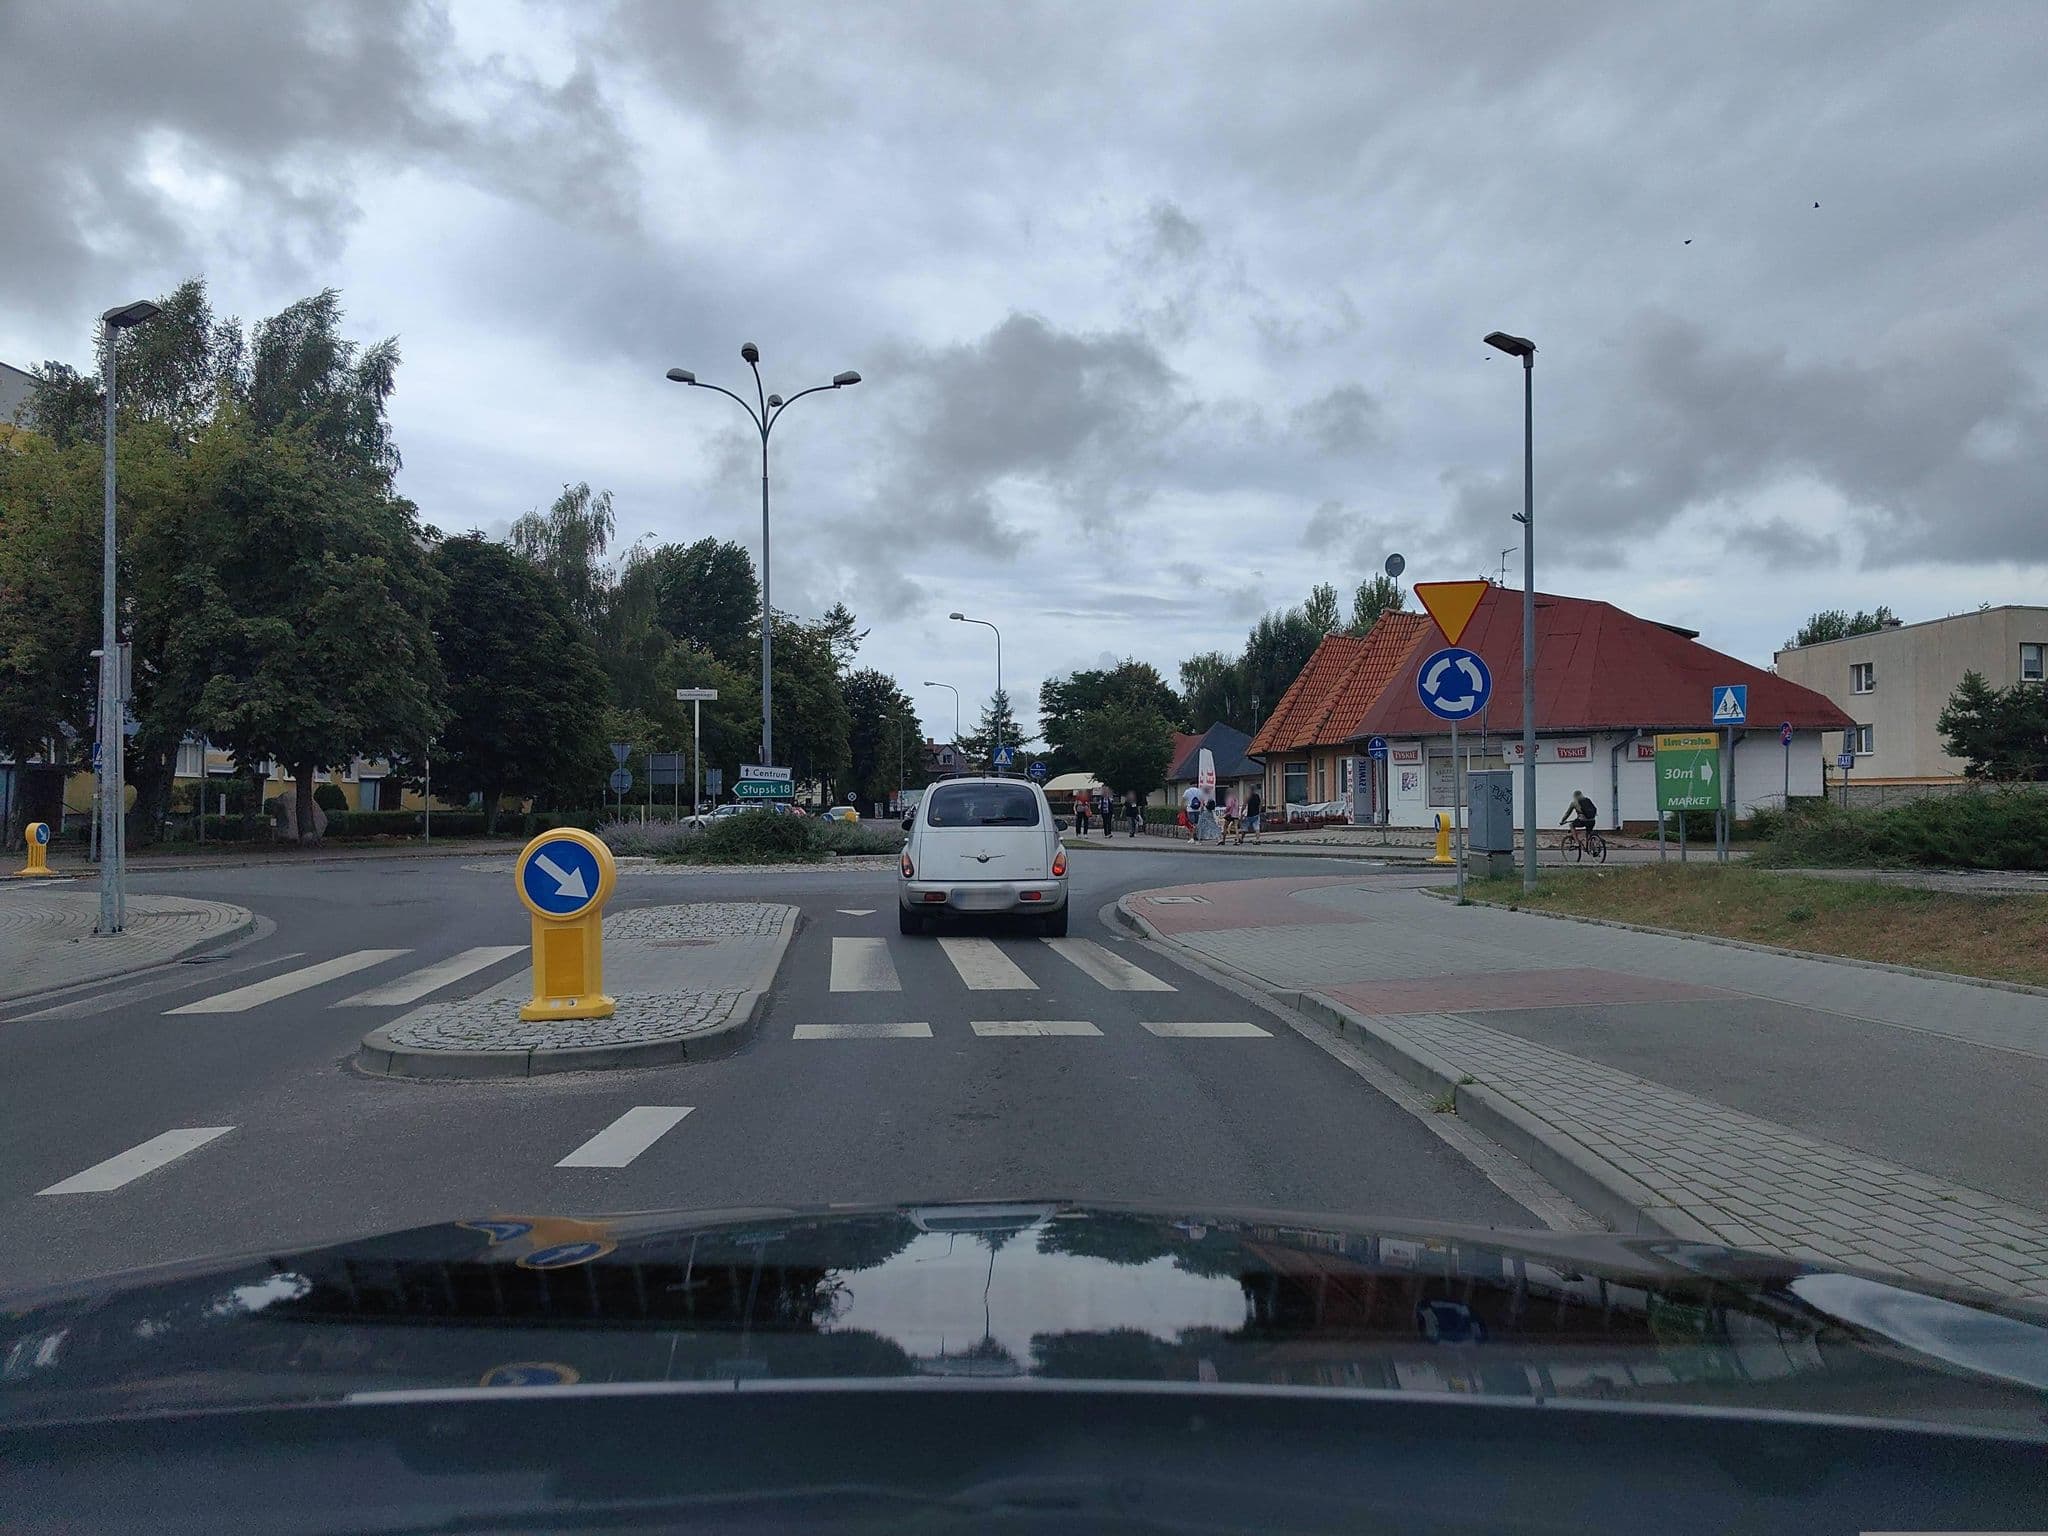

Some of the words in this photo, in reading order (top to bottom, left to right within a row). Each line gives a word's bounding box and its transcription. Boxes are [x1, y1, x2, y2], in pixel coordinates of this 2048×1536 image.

[1394, 751, 1417, 760] TYSKIE
[1559, 747, 1586, 758] TYSKIE
[753, 769, 788, 779] Centrum
[1664, 768, 1693, 780] 30m
[780, 784, 791, 793] 18
[1668, 796, 1712, 806] MARKET
